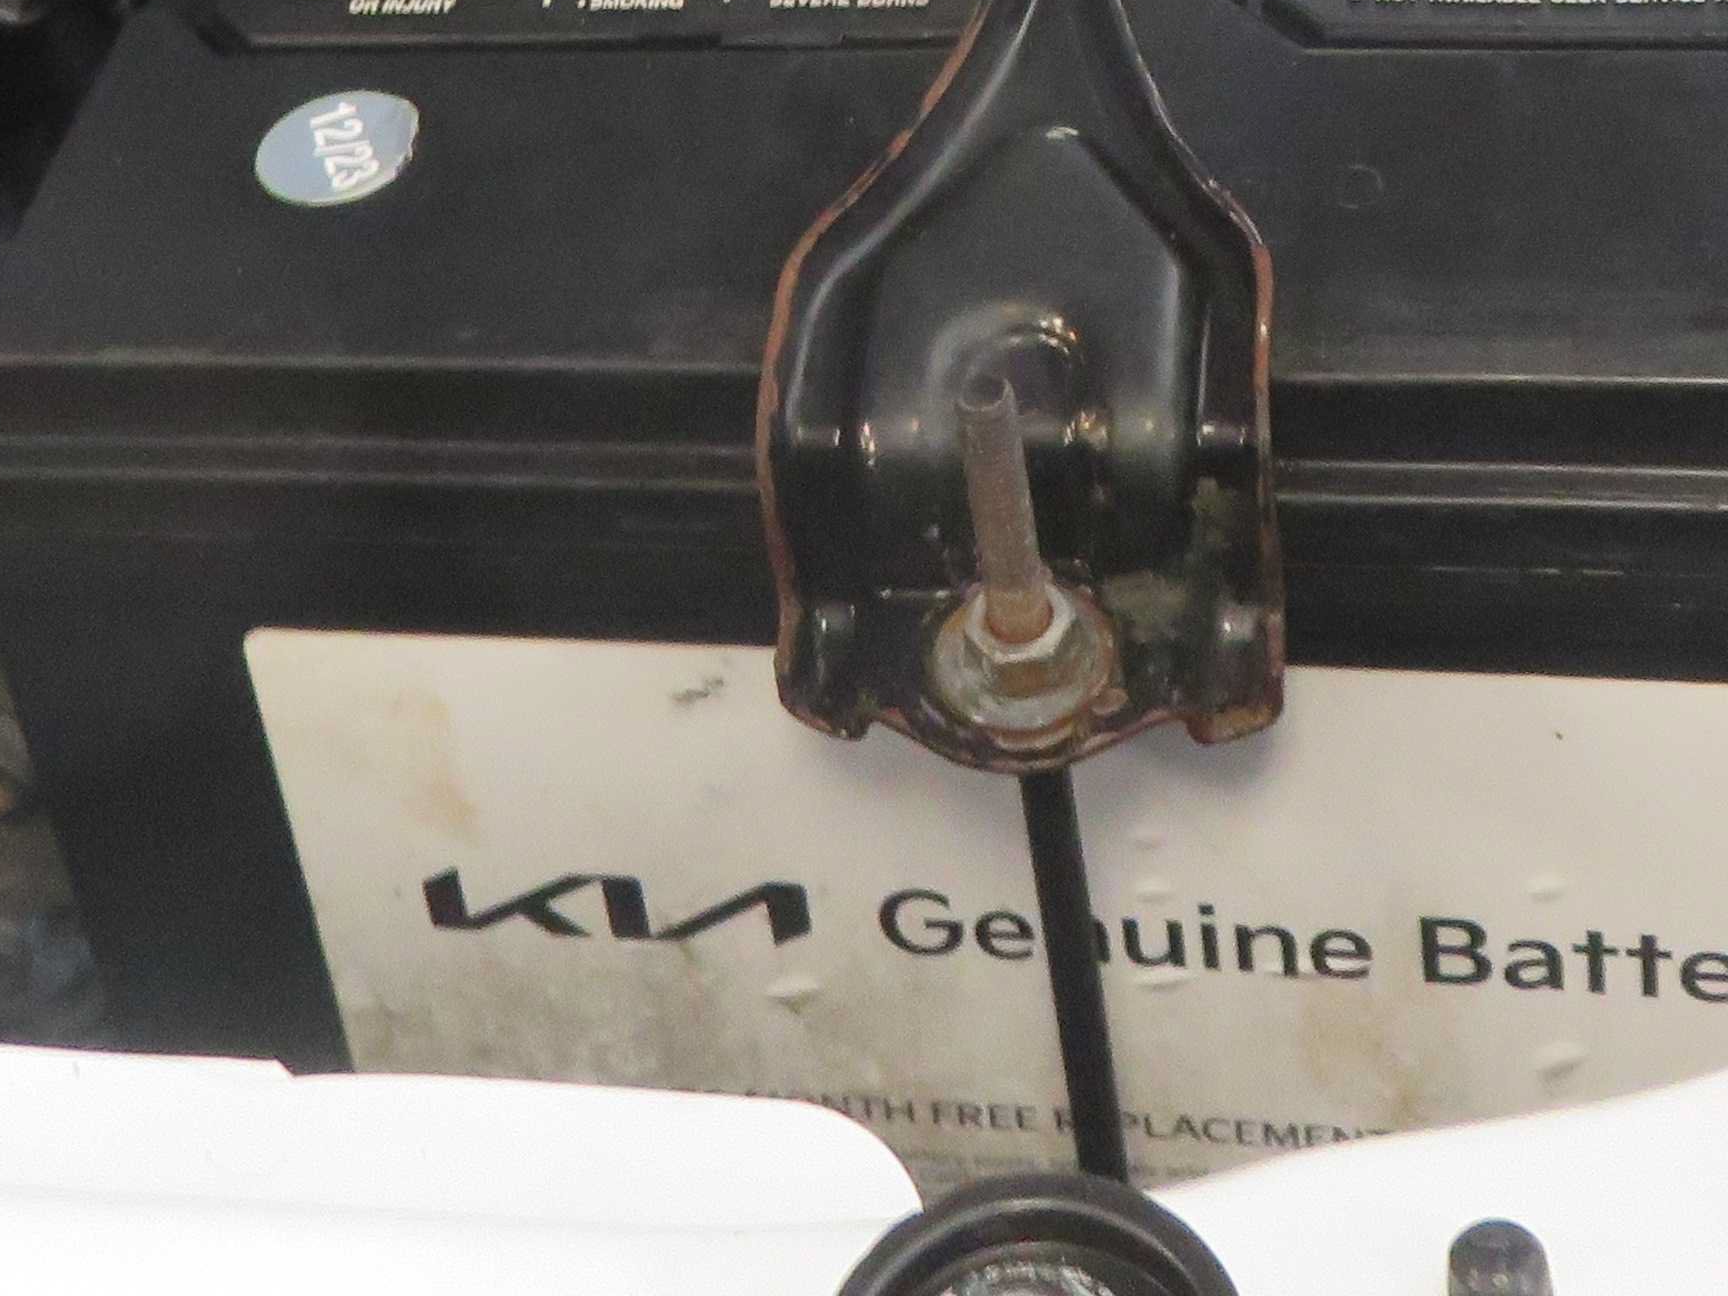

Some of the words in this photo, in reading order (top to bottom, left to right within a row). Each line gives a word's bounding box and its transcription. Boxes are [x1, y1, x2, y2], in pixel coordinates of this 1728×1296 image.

[309, 101, 381, 192] 12/23
[422, 865, 812, 947] KIA
[932, 1100, 1034, 1133] FREE
